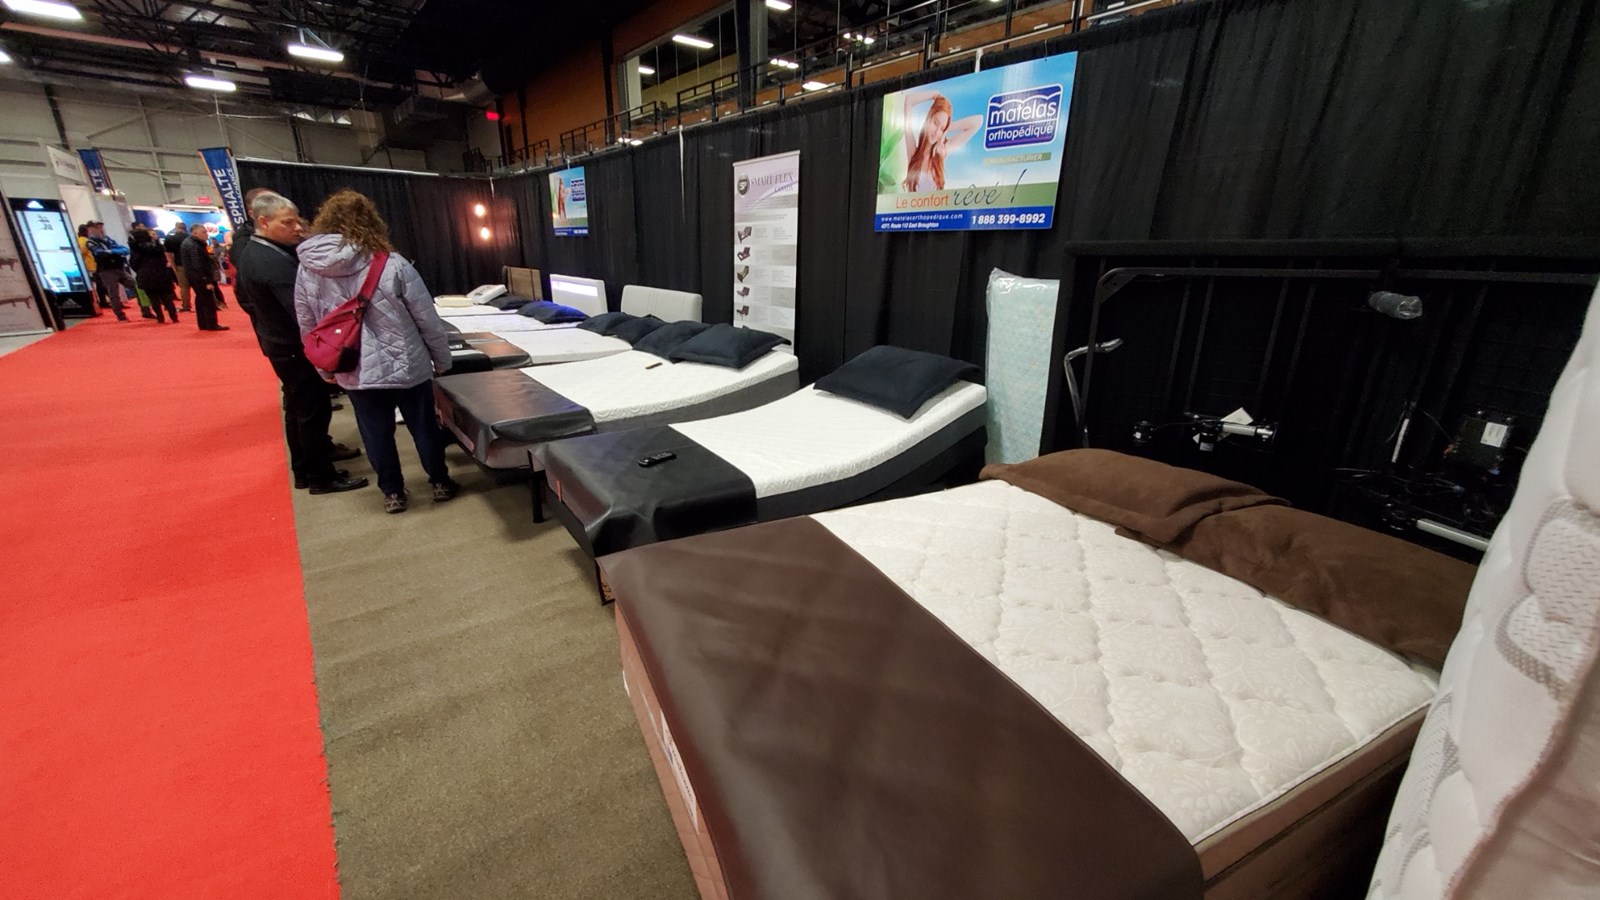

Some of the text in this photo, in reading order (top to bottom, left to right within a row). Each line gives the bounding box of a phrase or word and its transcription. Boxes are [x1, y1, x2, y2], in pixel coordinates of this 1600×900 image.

[990, 99, 1057, 125] matelas
[988, 124, 1053, 141] orthopédique
[775, 172, 794, 184] FLEX
[213, 168, 245, 229] SPHALTE
[896, 197, 907, 209] Le
[910, 194, 949, 208] confort
[971, 213, 1046, 225] 1 888 399-8992
